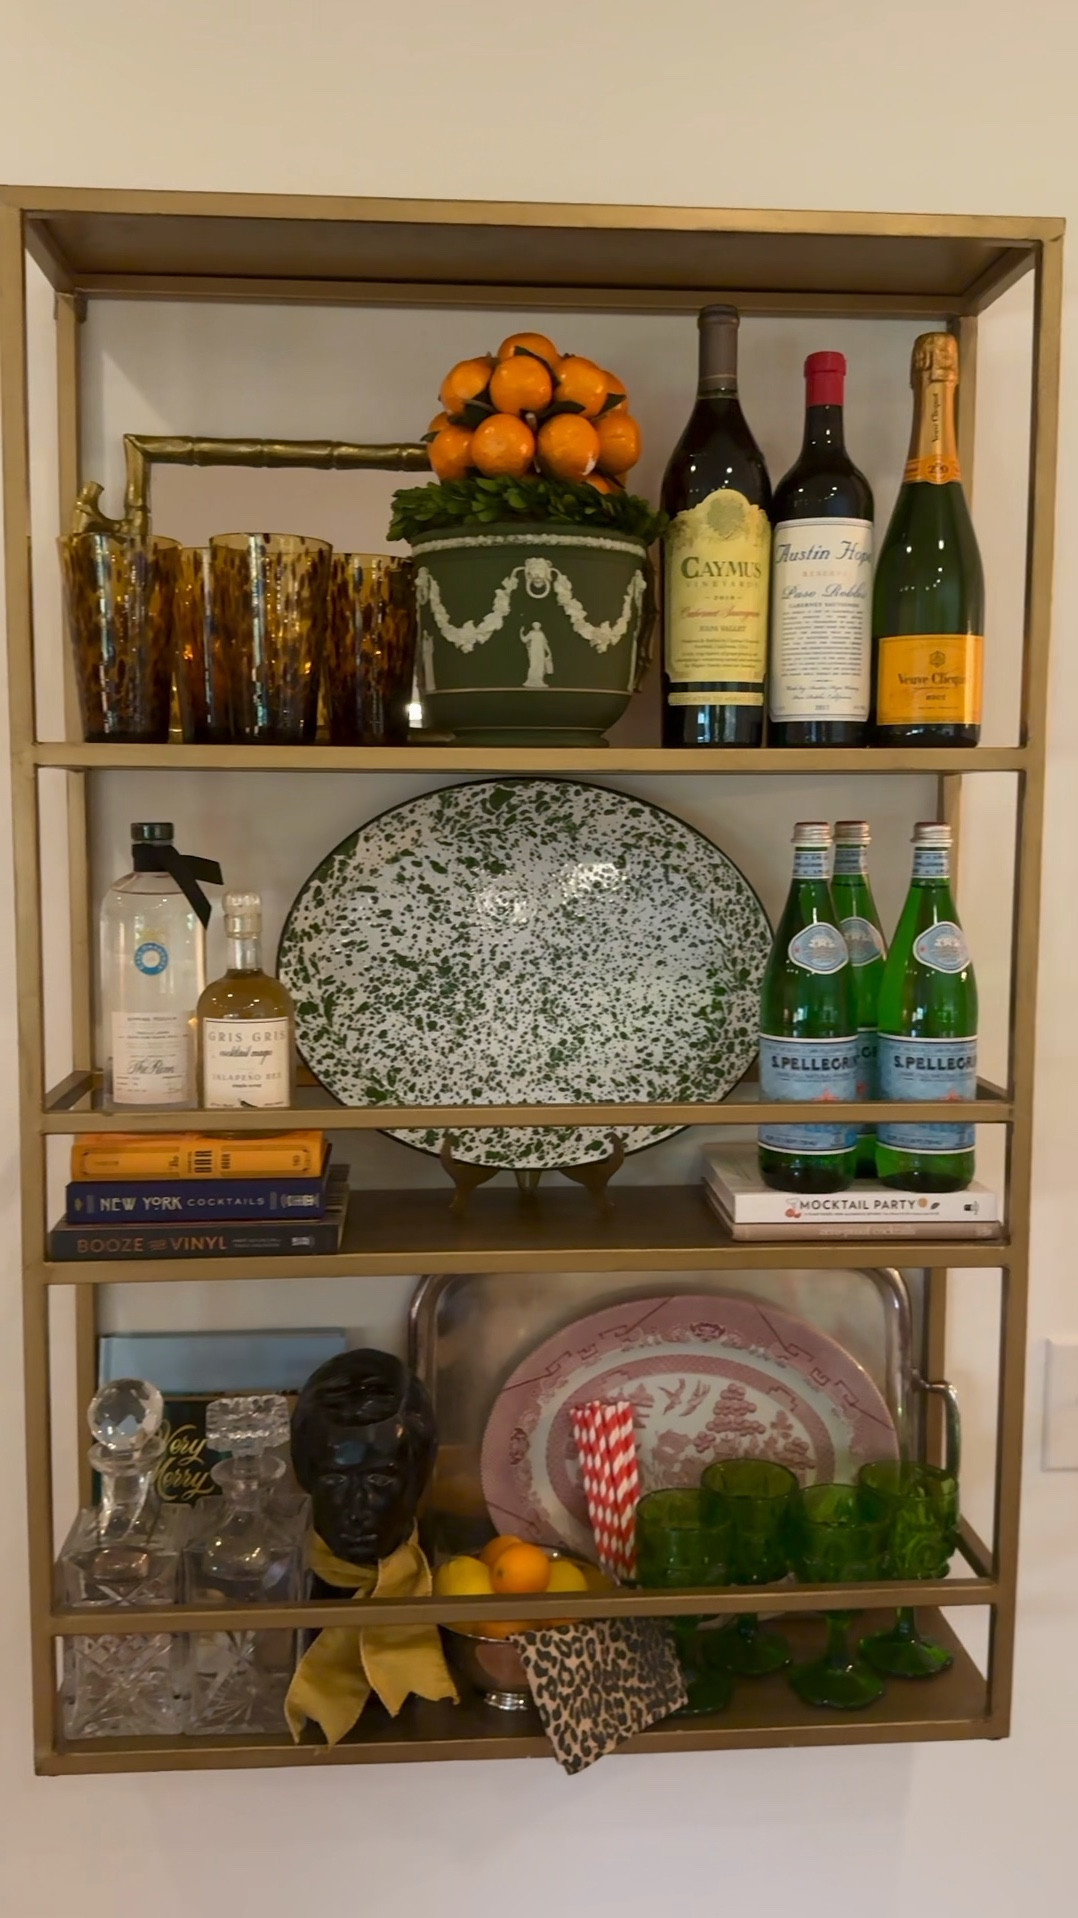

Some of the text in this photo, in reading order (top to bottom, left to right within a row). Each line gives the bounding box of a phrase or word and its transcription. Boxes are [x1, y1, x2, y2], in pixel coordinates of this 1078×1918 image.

[775, 543, 831, 564] Austin
[681, 556, 762, 579] CAYMUS
[781, 581, 867, 600] Paso Robles
[898, 673, 929, 685] Veuve
[208, 1031, 286, 1042] GRIS GRIS
[99, 1197, 136, 1212] NEW
[142, 1196, 183, 1211] YORK
[186, 1197, 265, 1207] COCKTAILS
[800, 1199, 916, 1210] MOCKTAIL PARTY
[77, 1237, 144, 1253] BOOZE
[169, 1236, 228, 1251] VINYL
